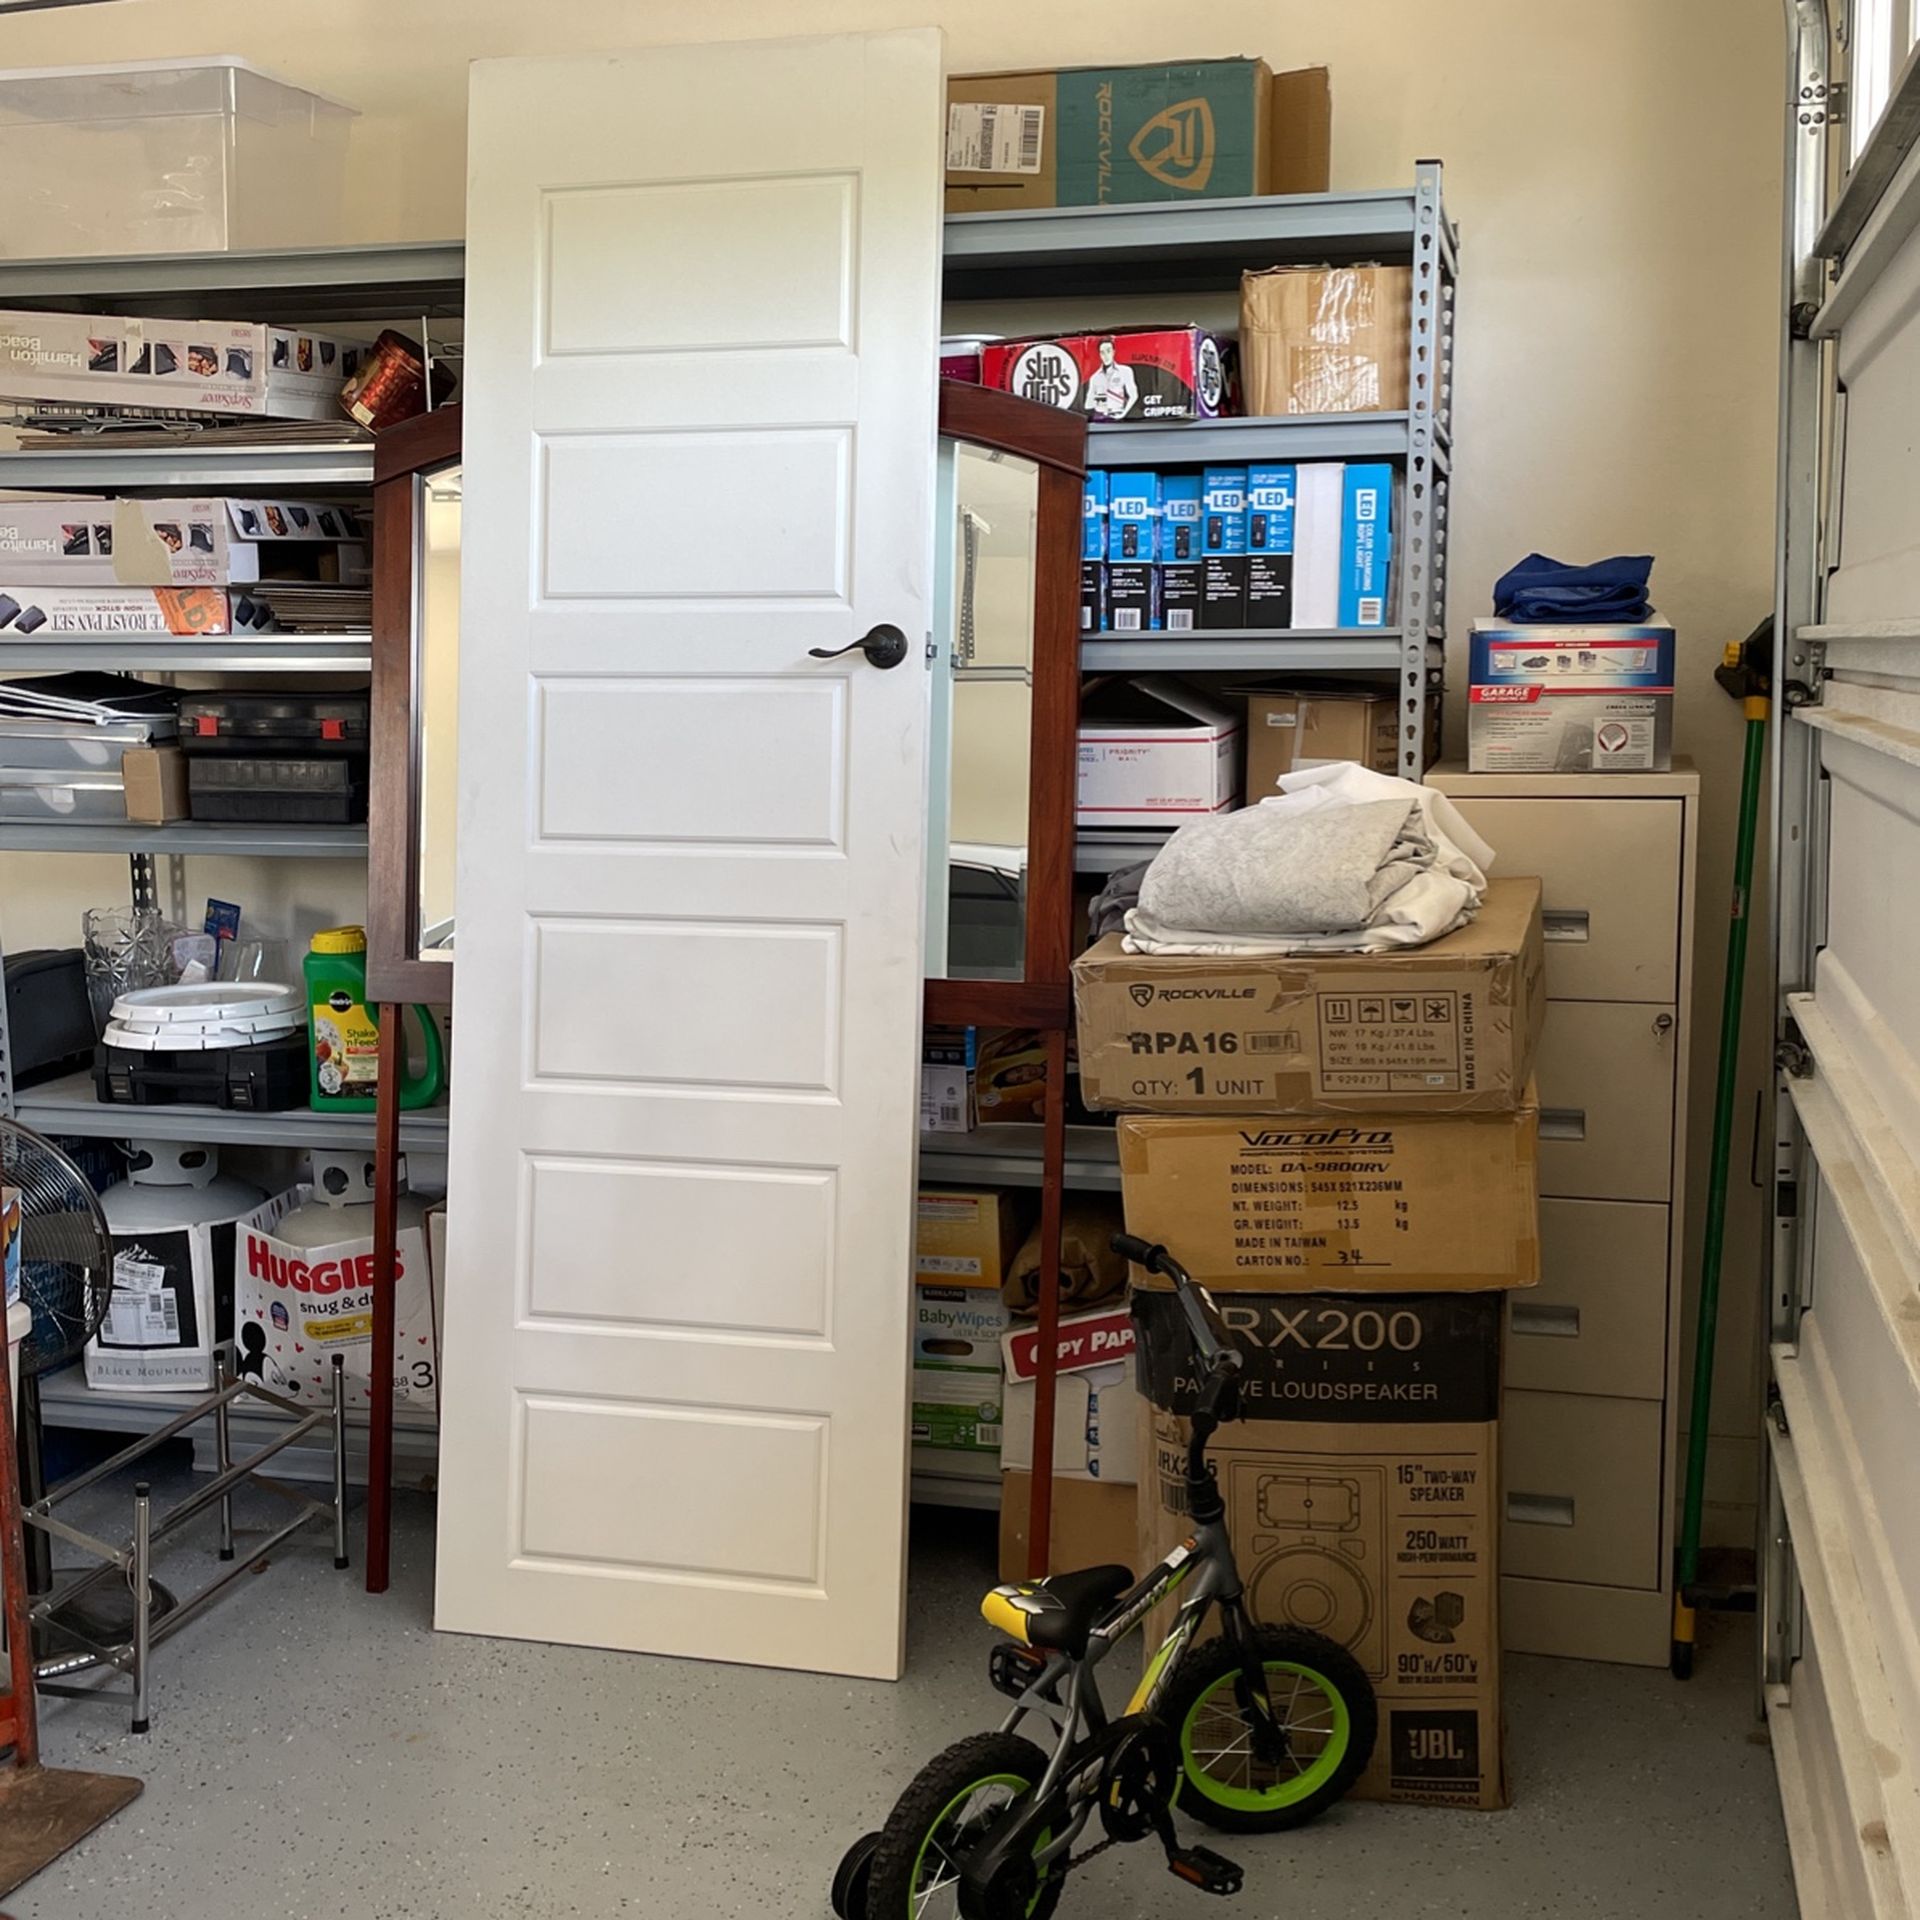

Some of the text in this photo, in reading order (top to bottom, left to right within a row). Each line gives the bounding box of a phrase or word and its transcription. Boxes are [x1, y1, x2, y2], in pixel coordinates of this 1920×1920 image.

[1095, 80, 1112, 205] ROCKVILL
[0, 336, 41, 351] Beac
[10, 350, 81, 367] Hamilton
[1026, 352, 1063, 379] slip
[201, 391, 255, 409] StepSavor
[1144, 395, 1162, 405] GET
[1213, 494, 1240, 508] LED
[1257, 492, 1284, 506] LED
[1360, 493, 1373, 517] LED
[1118, 501, 1144, 515] LED
[1171, 504, 1196, 517] LED
[0, 539, 57, 553] Hamilto
[1355, 546, 1364, 568] LIGHT
[1363, 523, 1374, 591] COLOR CHANGING
[173, 567, 217, 582] StepSavo
[51, 614, 75, 631] SET
[78, 614, 102, 631] PAN
[105, 614, 146, 631] ROAST
[1481, 688, 1530, 697] GARAGE
[1158, 988, 1256, 1001] ROCKVILLE
[346, 1029, 377, 1038] Shake
[1355, 1029, 1366, 1037] 17
[1371, 1029, 1385, 1039] Kg
[1393, 1028, 1414, 1037] 37.4
[353, 1038, 378, 1046] Feed
[1129, 1032, 1238, 1054] RPA16
[1371, 1043, 1385, 1052] Kg
[1462, 993, 1475, 1090] MADE IN CHINA
[1132, 1066, 1264, 1096] QTY: 1 UNIT
[1338, 1075, 1381, 1084] 929477
[1231, 1162, 1390, 1175] MODEL: DA-9800RV
[1232, 1182, 1308, 1193] DIMENSIONS:
[1311, 1182, 1336, 1193] 545X
[1233, 1200, 1408, 1213] NT. WEIGHT: 12.5 kg
[1337, 1218, 1360, 1230] 13.5
[1395, 1218, 1408, 1231] kg
[1235, 1237, 1327, 1248] MADE IN TAIWAN
[1236, 1255, 1282, 1267] CARTON
[300, 1292, 374, 1315] snug & dr
[1221, 1307, 1423, 1351] RX200
[1030, 1328, 1136, 1364] CPY PAP
[97, 1365, 203, 1377] BLACK MOUNTAIN
[411, 1361, 434, 1389] 3
[1271, 1381, 1438, 1400] LOUDSPEAKER
[1158, 1448, 1217, 1479] JRX25
[1396, 1464, 1476, 1484] 15" TWO-WAY
[1409, 1487, 1465, 1501] SPEAKER
[1406, 1530, 1468, 1550] 250 WATT
[1397, 1552, 1477, 1563] HIGH-PERFORMANCE
[1409, 1728, 1464, 1761] JBL
[1404, 1792, 1480, 1805] HARMAN
